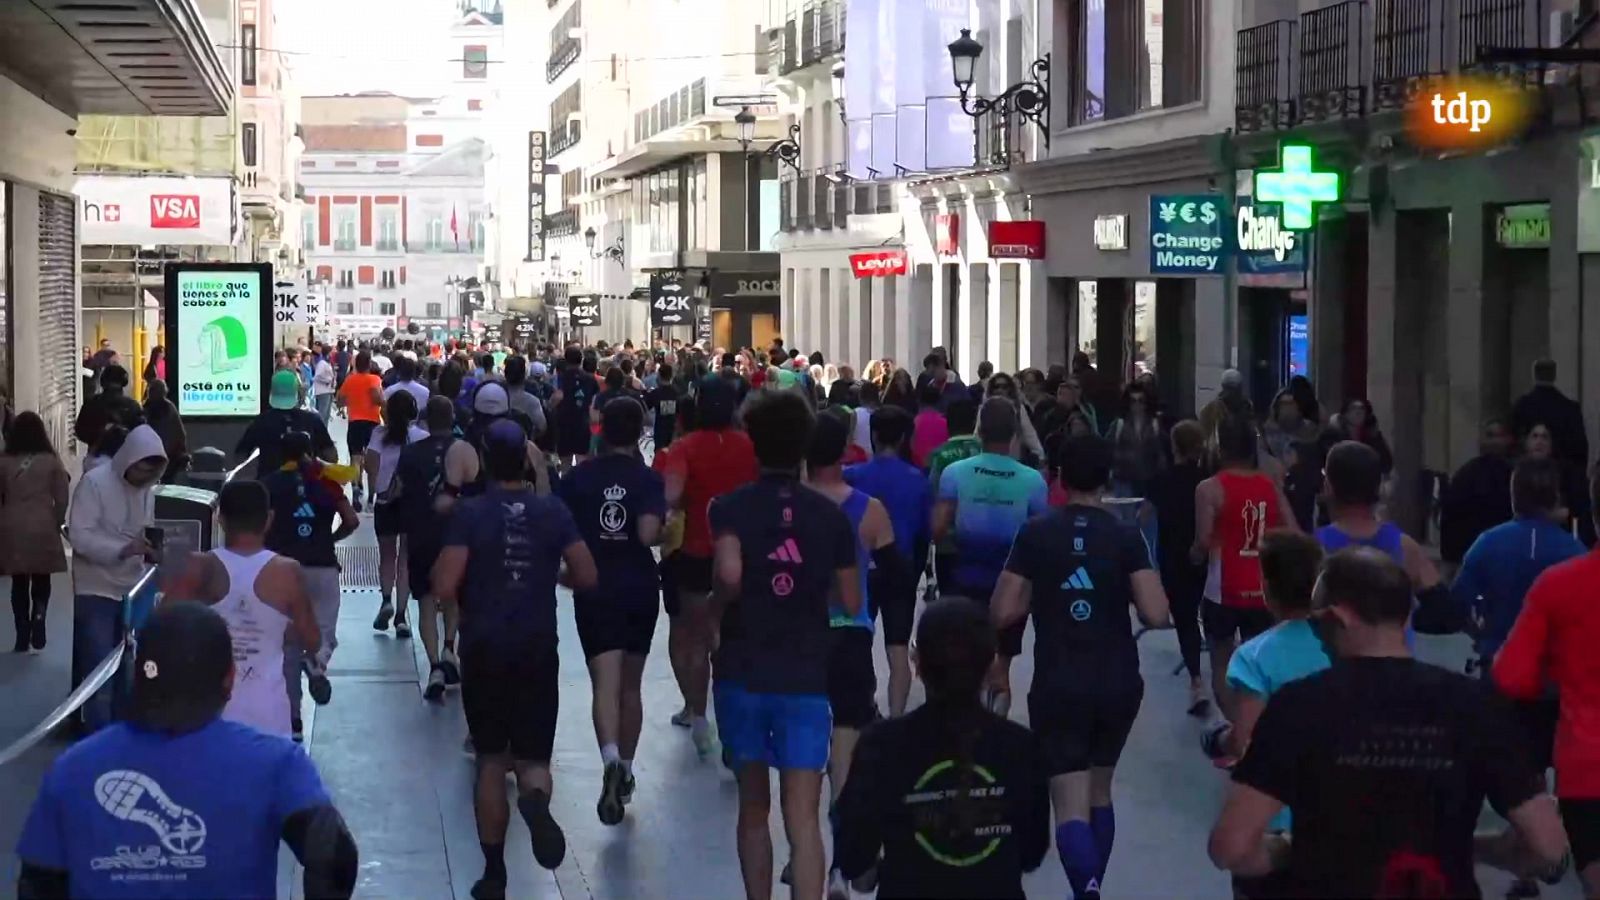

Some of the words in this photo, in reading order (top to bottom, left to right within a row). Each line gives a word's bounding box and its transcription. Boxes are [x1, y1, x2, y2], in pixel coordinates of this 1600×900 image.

[1152, 232, 1223, 251] Change
[1156, 252, 1218, 270] Money
[226, 282, 248, 291] que
[182, 290, 219, 298] tienes
[221, 290, 236, 298] en
[239, 290, 250, 298] la
[654, 296, 690, 311] 42K
[572, 305, 599, 317] 42K
[216, 382, 233, 391] en
[237, 382, 250, 391] tu
